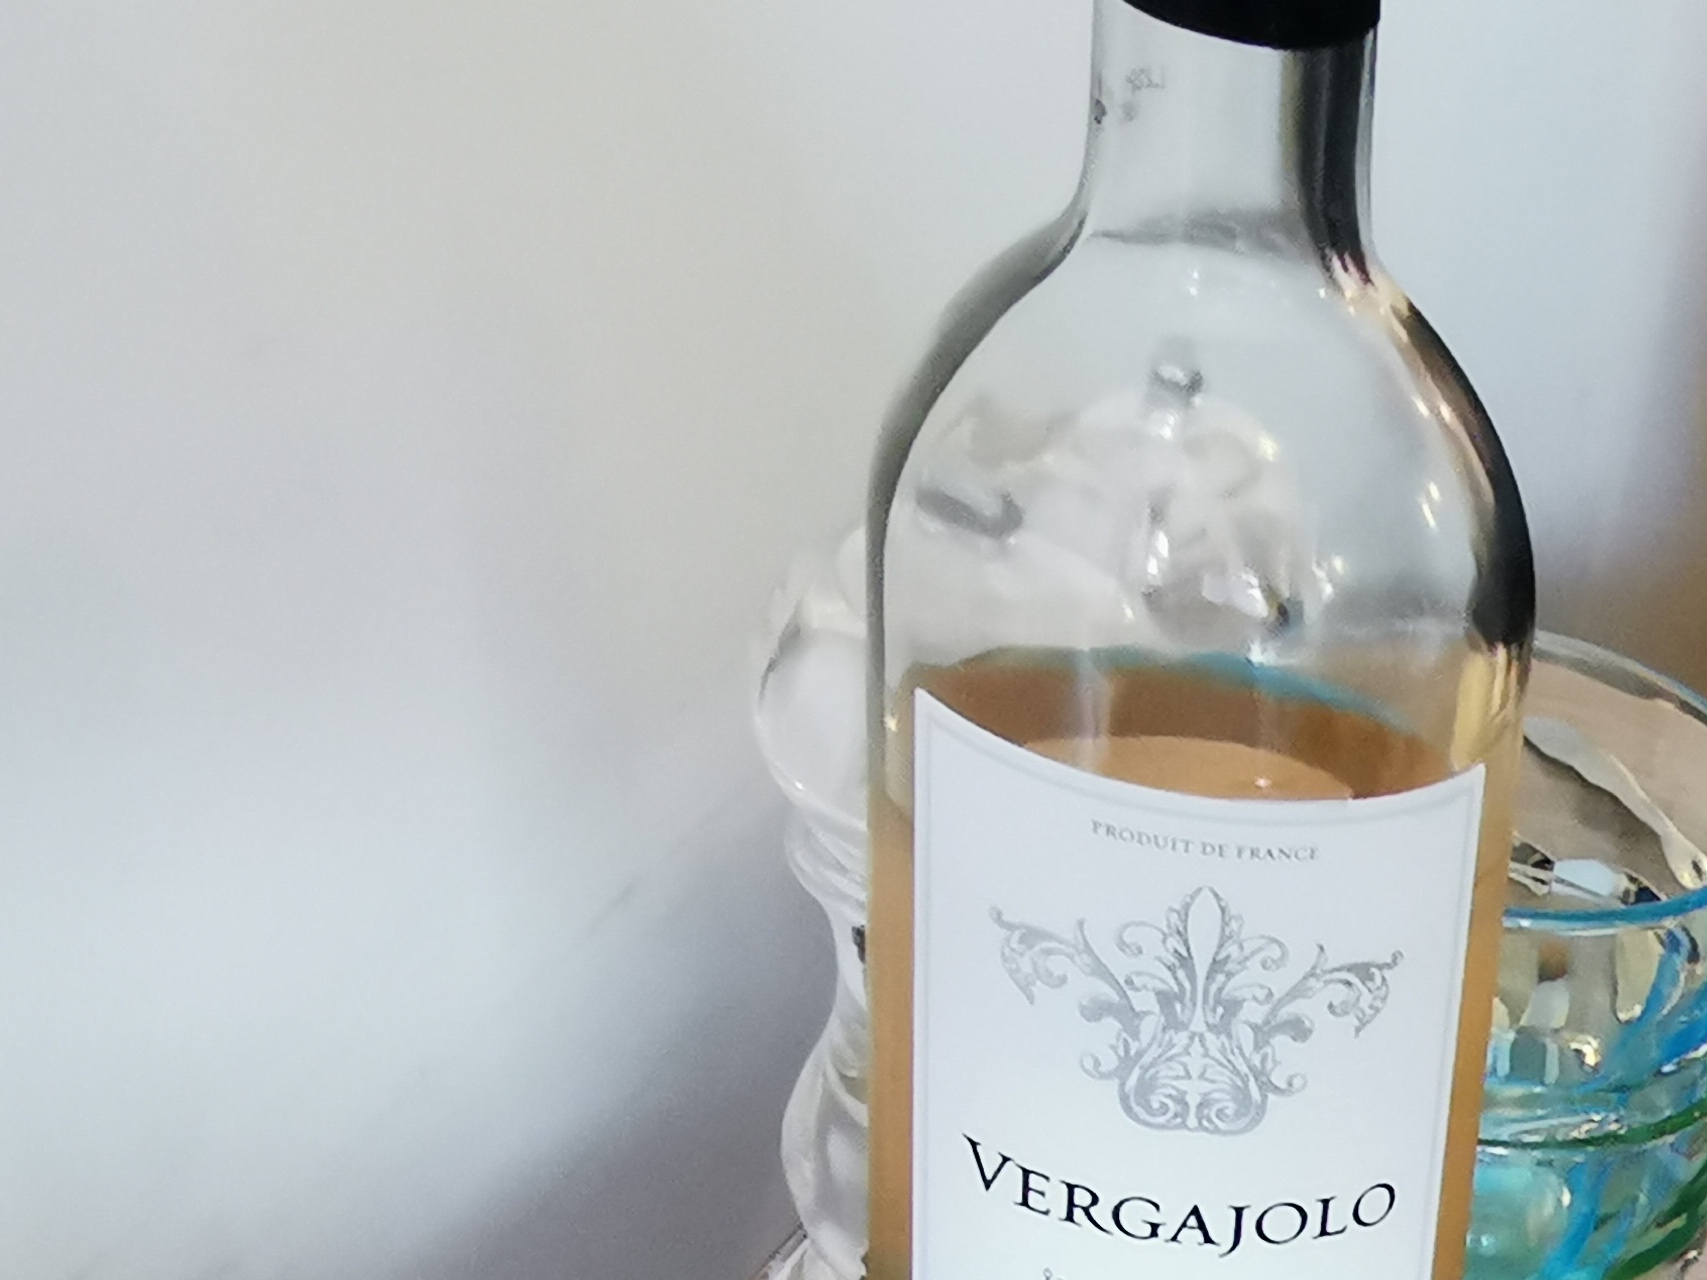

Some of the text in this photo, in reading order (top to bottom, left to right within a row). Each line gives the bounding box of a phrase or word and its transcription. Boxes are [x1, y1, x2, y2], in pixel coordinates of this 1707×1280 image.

[1092, 818, 1319, 862] PRODUIT DE FRANCE
[962, 1133, 1396, 1258] VERGAJOLO
